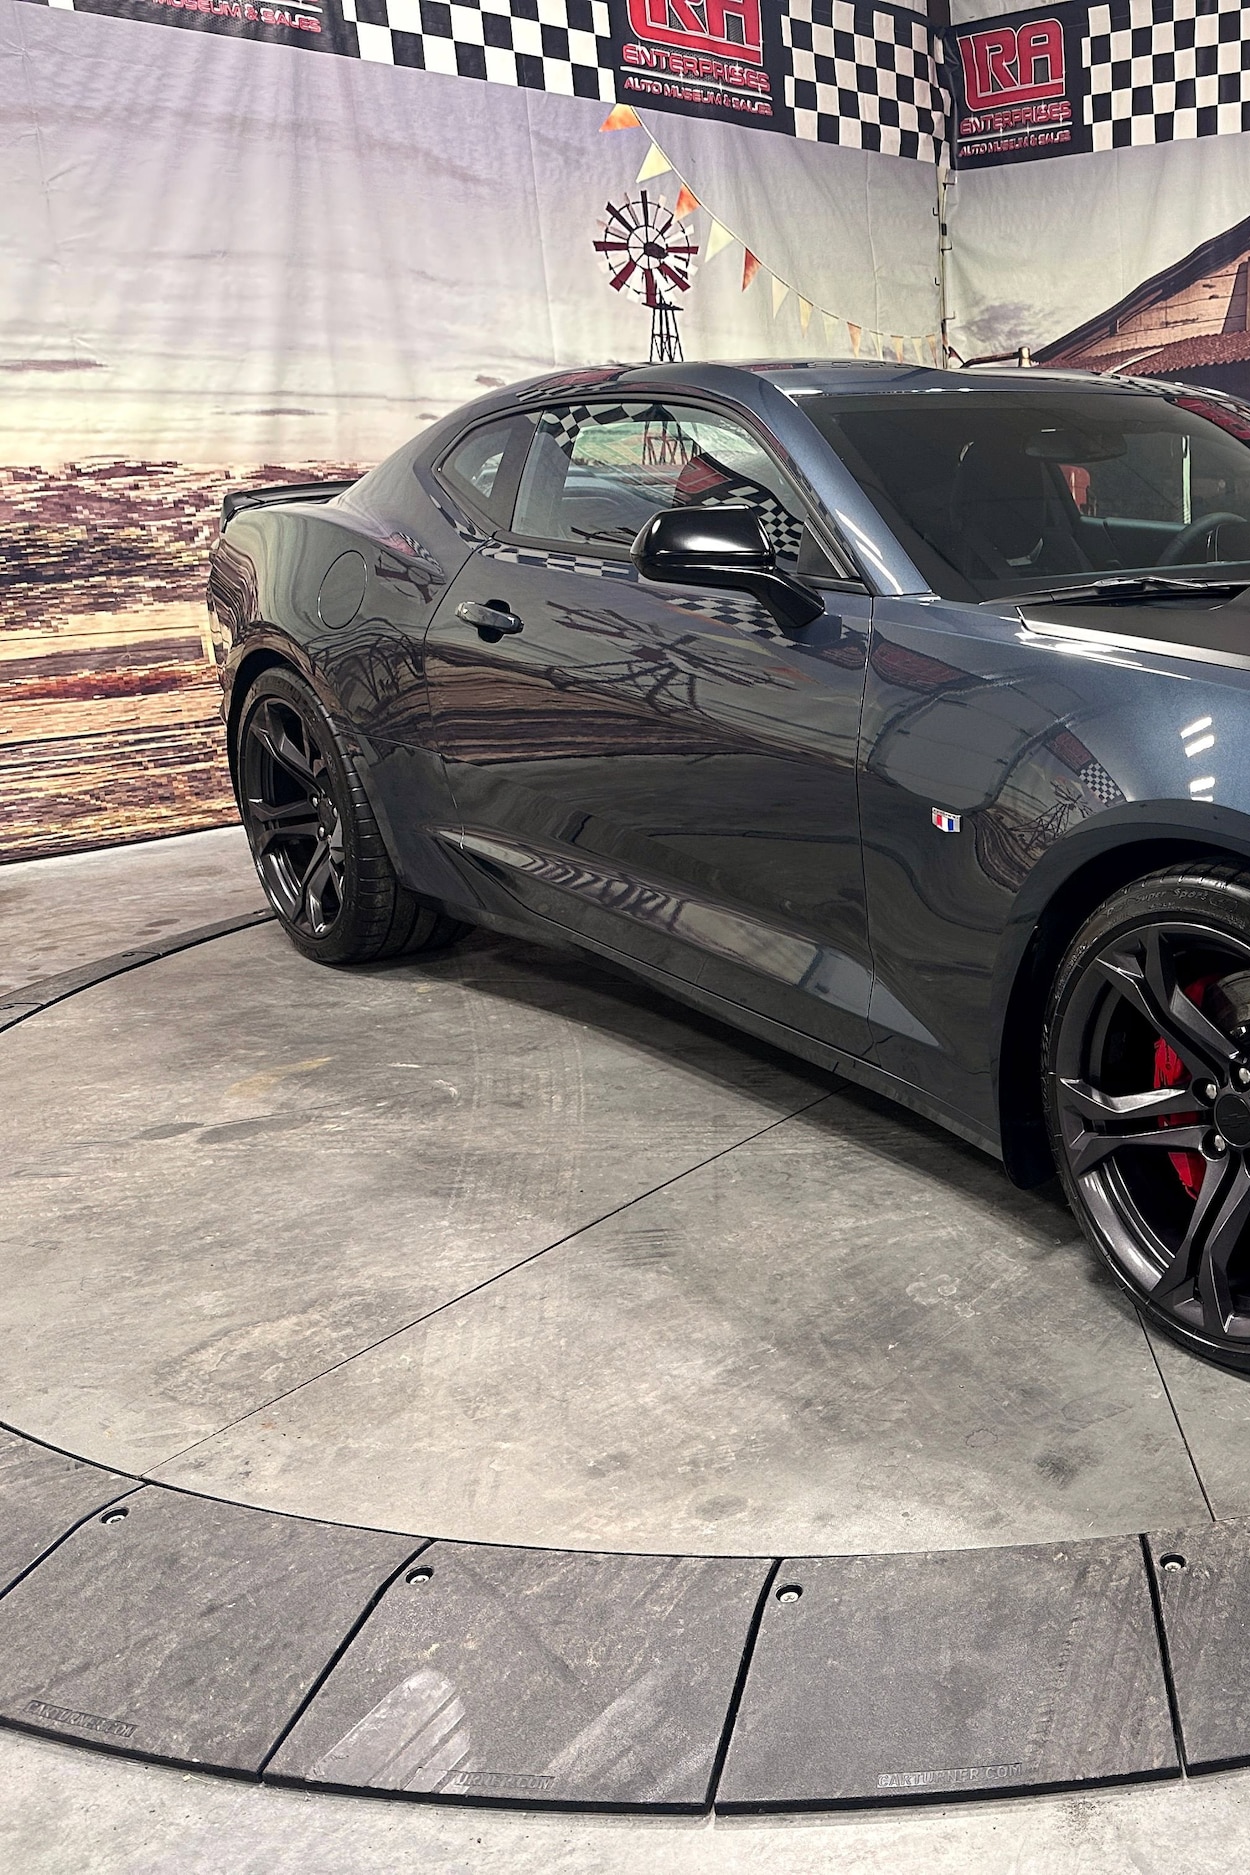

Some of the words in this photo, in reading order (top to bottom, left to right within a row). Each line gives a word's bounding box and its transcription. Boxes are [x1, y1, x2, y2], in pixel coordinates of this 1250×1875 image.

[245, 3, 258, 21] &
[260, 8, 321, 33] SALES
[622, 43, 771, 92] ENTERPRISES
[624, 76, 663, 95] AUTO
[664, 83, 722, 106] MUSEUM
[732, 98, 773, 116] SALES
[960, 101, 1072, 135] ENTERPRISES
[958, 143, 987, 157] AUTO
